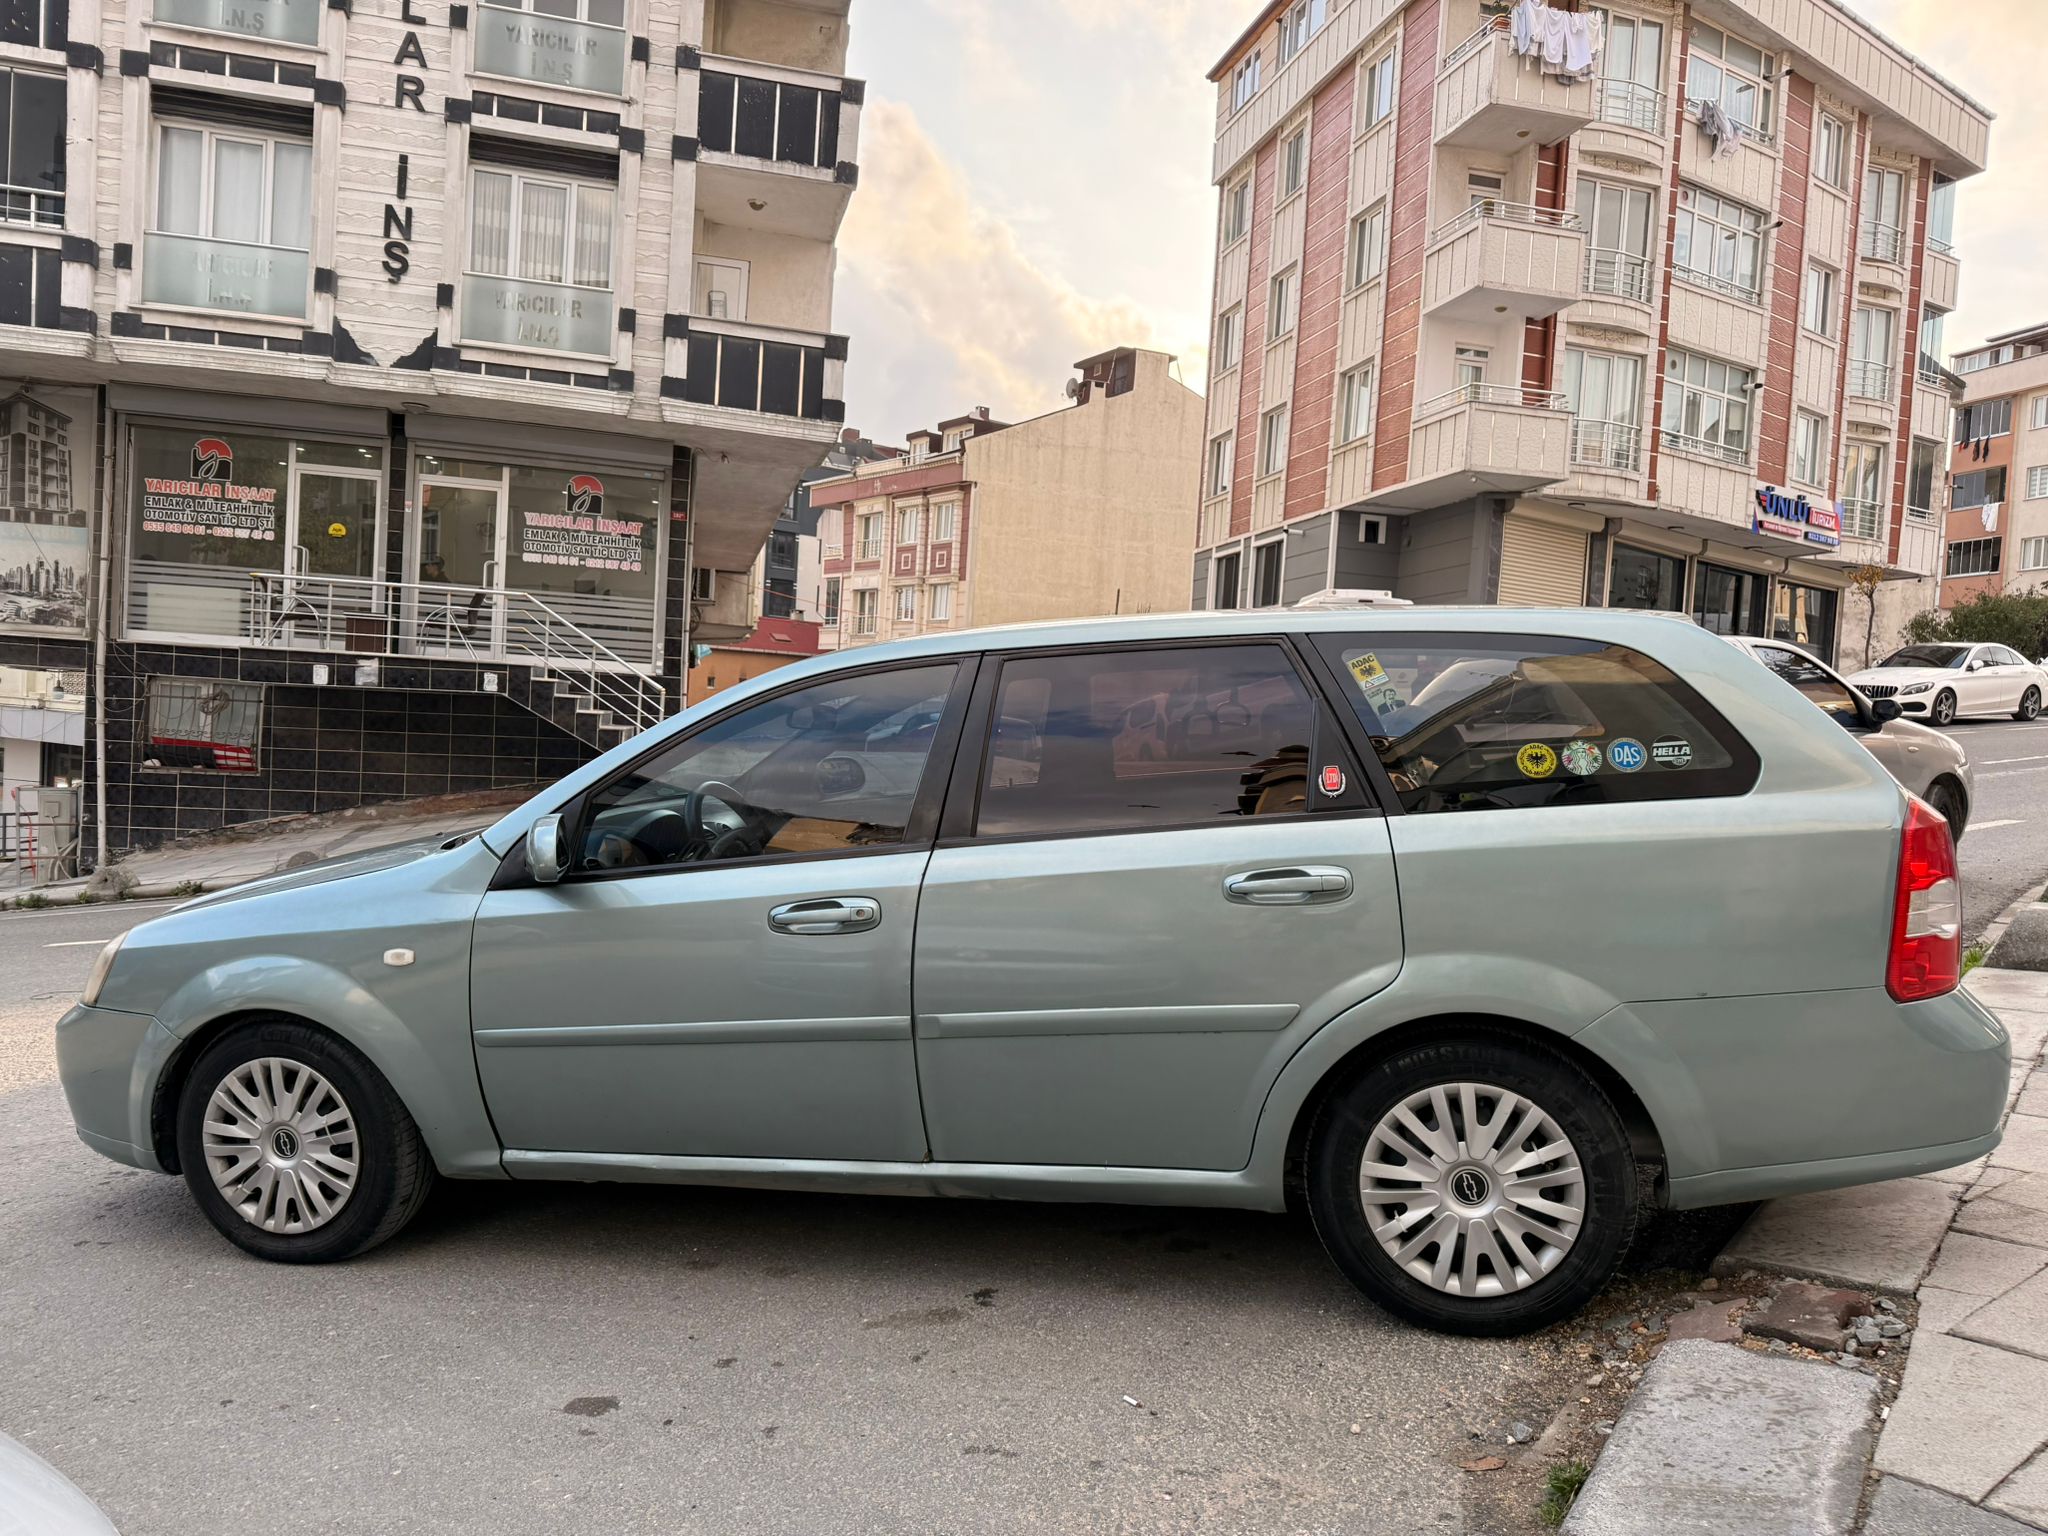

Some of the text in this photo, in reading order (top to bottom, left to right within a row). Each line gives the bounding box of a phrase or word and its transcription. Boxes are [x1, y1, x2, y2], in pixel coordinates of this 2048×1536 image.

[144, 478, 276, 503] YARICILAR İNŞAAT
[144, 496, 275, 516] EMLAK & MÜTEAHHİTLİK
[1757, 486, 1809, 523] ÜNLÜ
[143, 521, 164, 532] 0535
[144, 509, 197, 523] OTOMOTİV
[199, 513, 218, 525] SAN
[220, 513, 237, 527] TİC
[239, 516, 257, 528] LTD
[524, 511, 643, 536] YARICILAR İNŞAAT
[524, 528, 641, 549] EMLAK & MÜTEAHHİTLİK
[523, 541, 571, 554] OTOMOTİV
[572, 545, 590, 556] SAN
[593, 545, 608, 558] TİC
[609, 548, 625, 560] LTD
[1351, 655, 1375, 669] ADAC
[1614, 745, 1640, 765] DAS
[1652, 747, 1690, 757] HELLA
